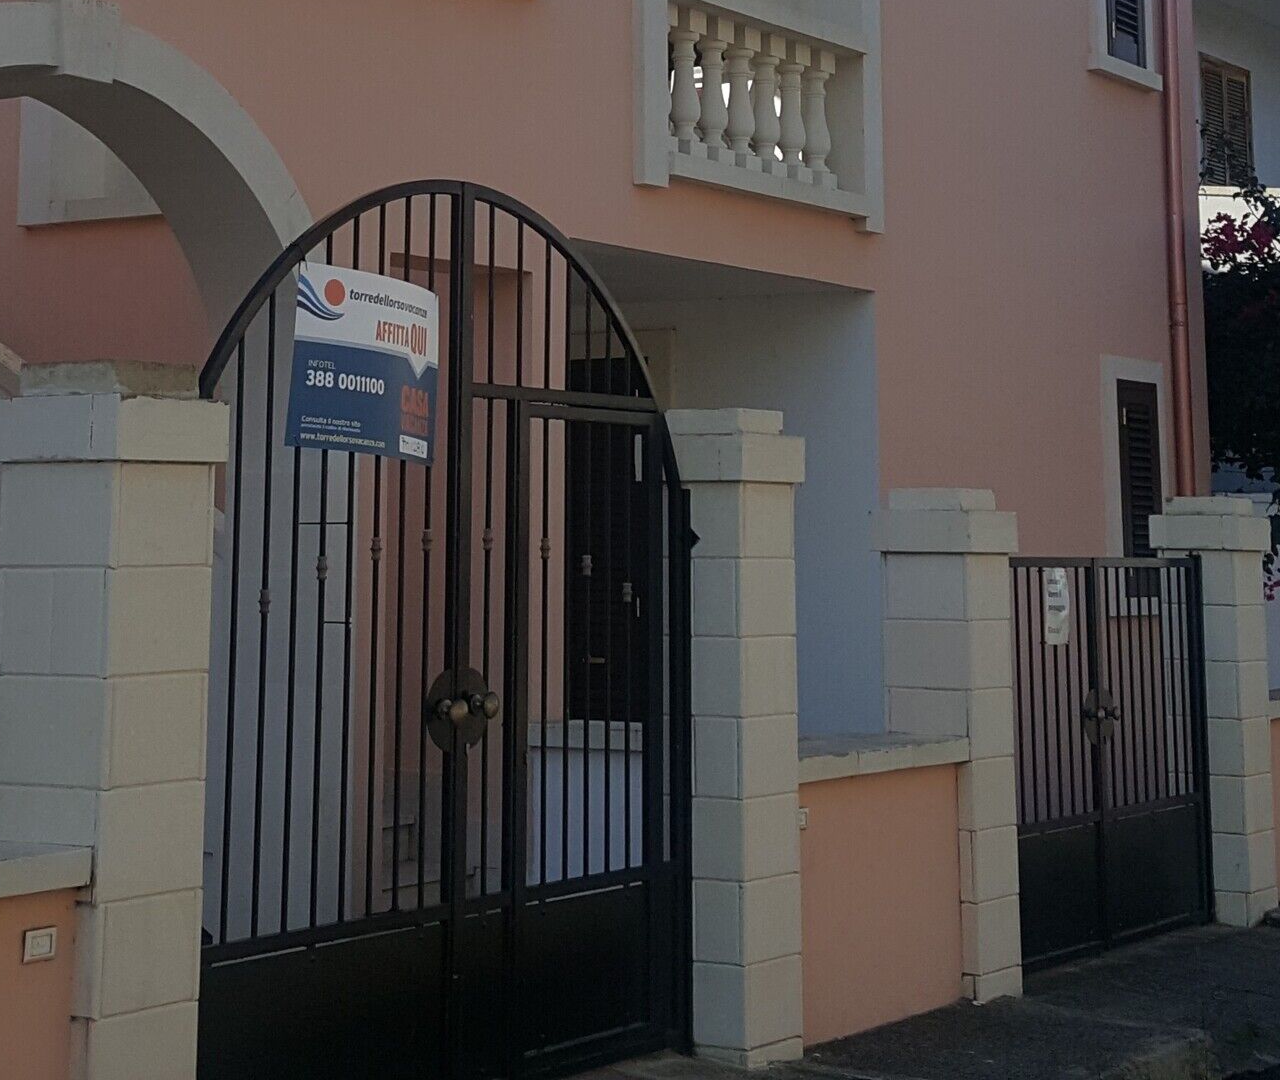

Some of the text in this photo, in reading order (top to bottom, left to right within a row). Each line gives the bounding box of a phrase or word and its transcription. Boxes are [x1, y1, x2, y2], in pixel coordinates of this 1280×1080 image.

[375, 320, 427, 356] AFFITTA QUI
[305, 369, 385, 395] 388 0011100
